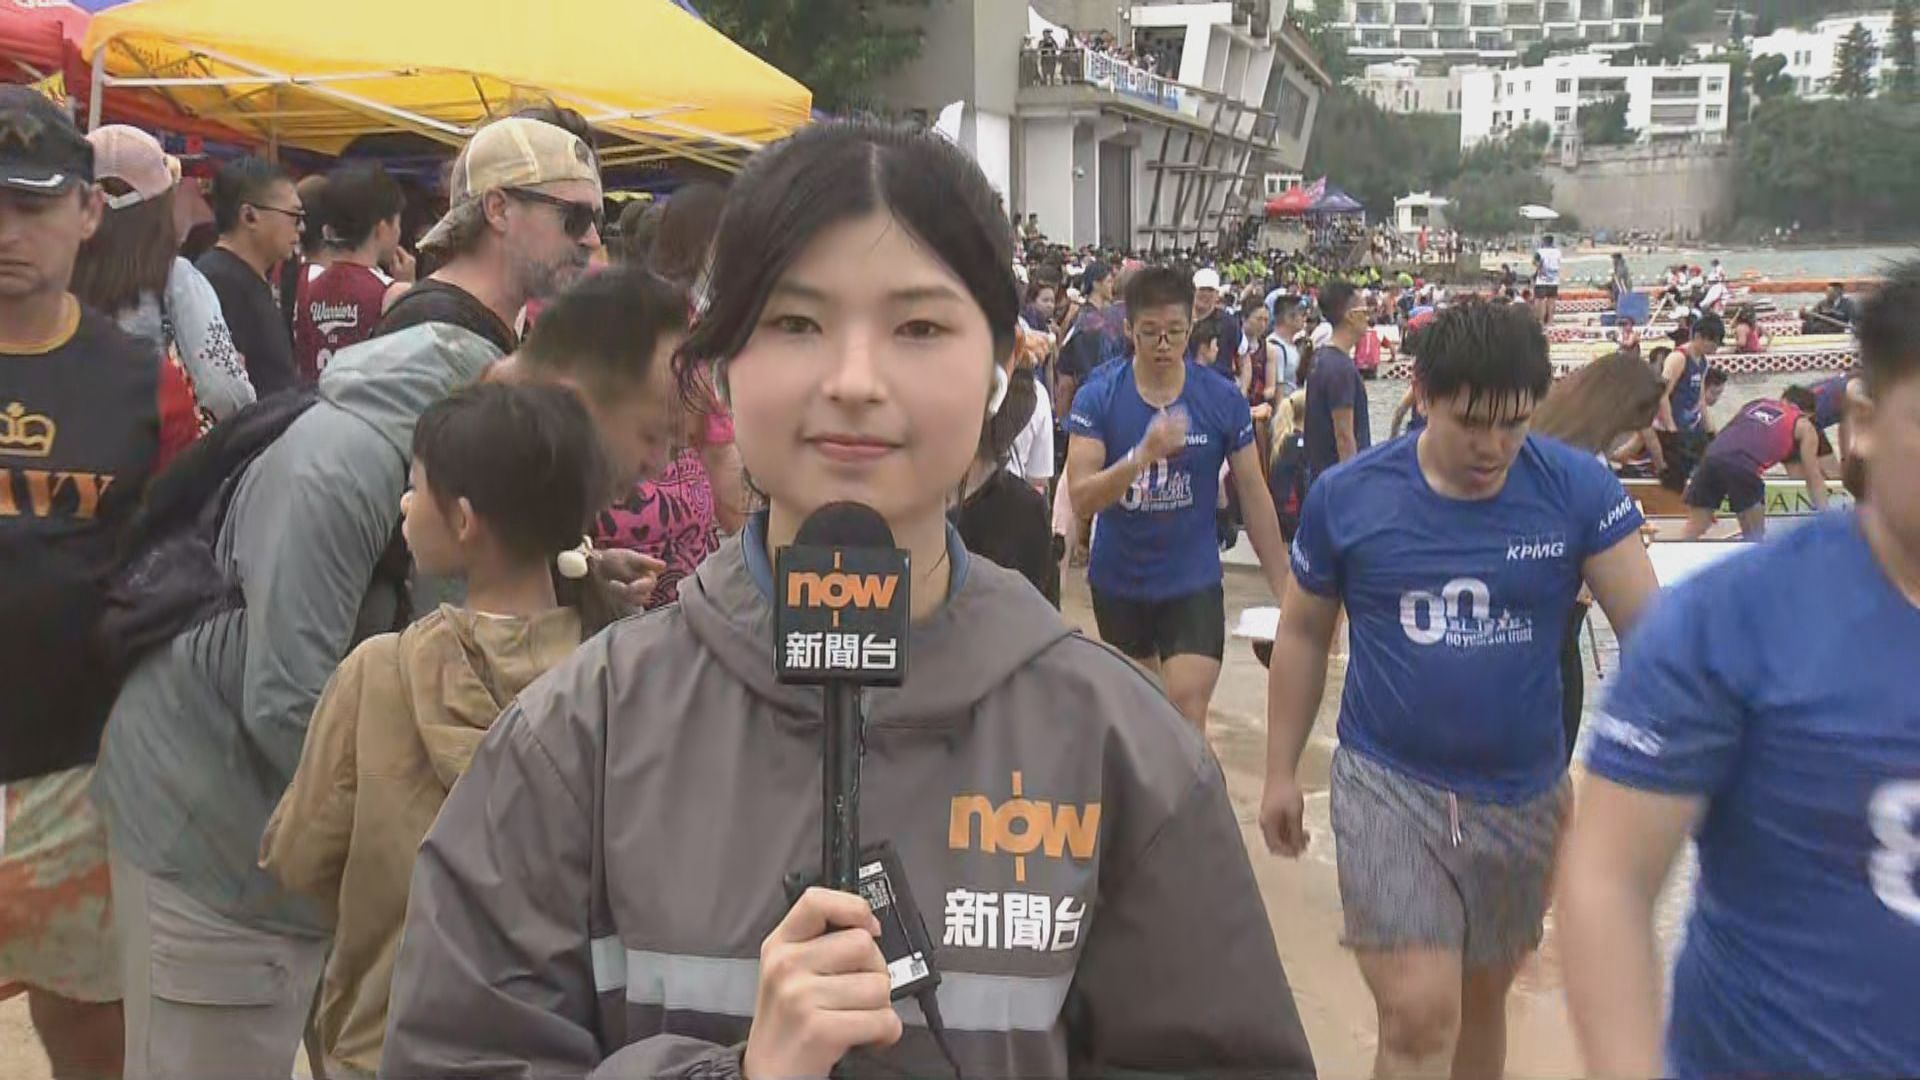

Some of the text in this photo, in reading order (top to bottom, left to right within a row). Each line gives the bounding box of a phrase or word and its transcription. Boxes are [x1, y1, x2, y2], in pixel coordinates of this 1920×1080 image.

[310, 300, 358, 323] Warriors
[1184, 433, 1208, 445] PMG
[1507, 541, 1565, 561] KPMG
[788, 571, 898, 608] now
[786, 632, 896, 669] 新聞台
[949, 795, 1101, 858] now
[943, 888, 1085, 951] 新聞台
